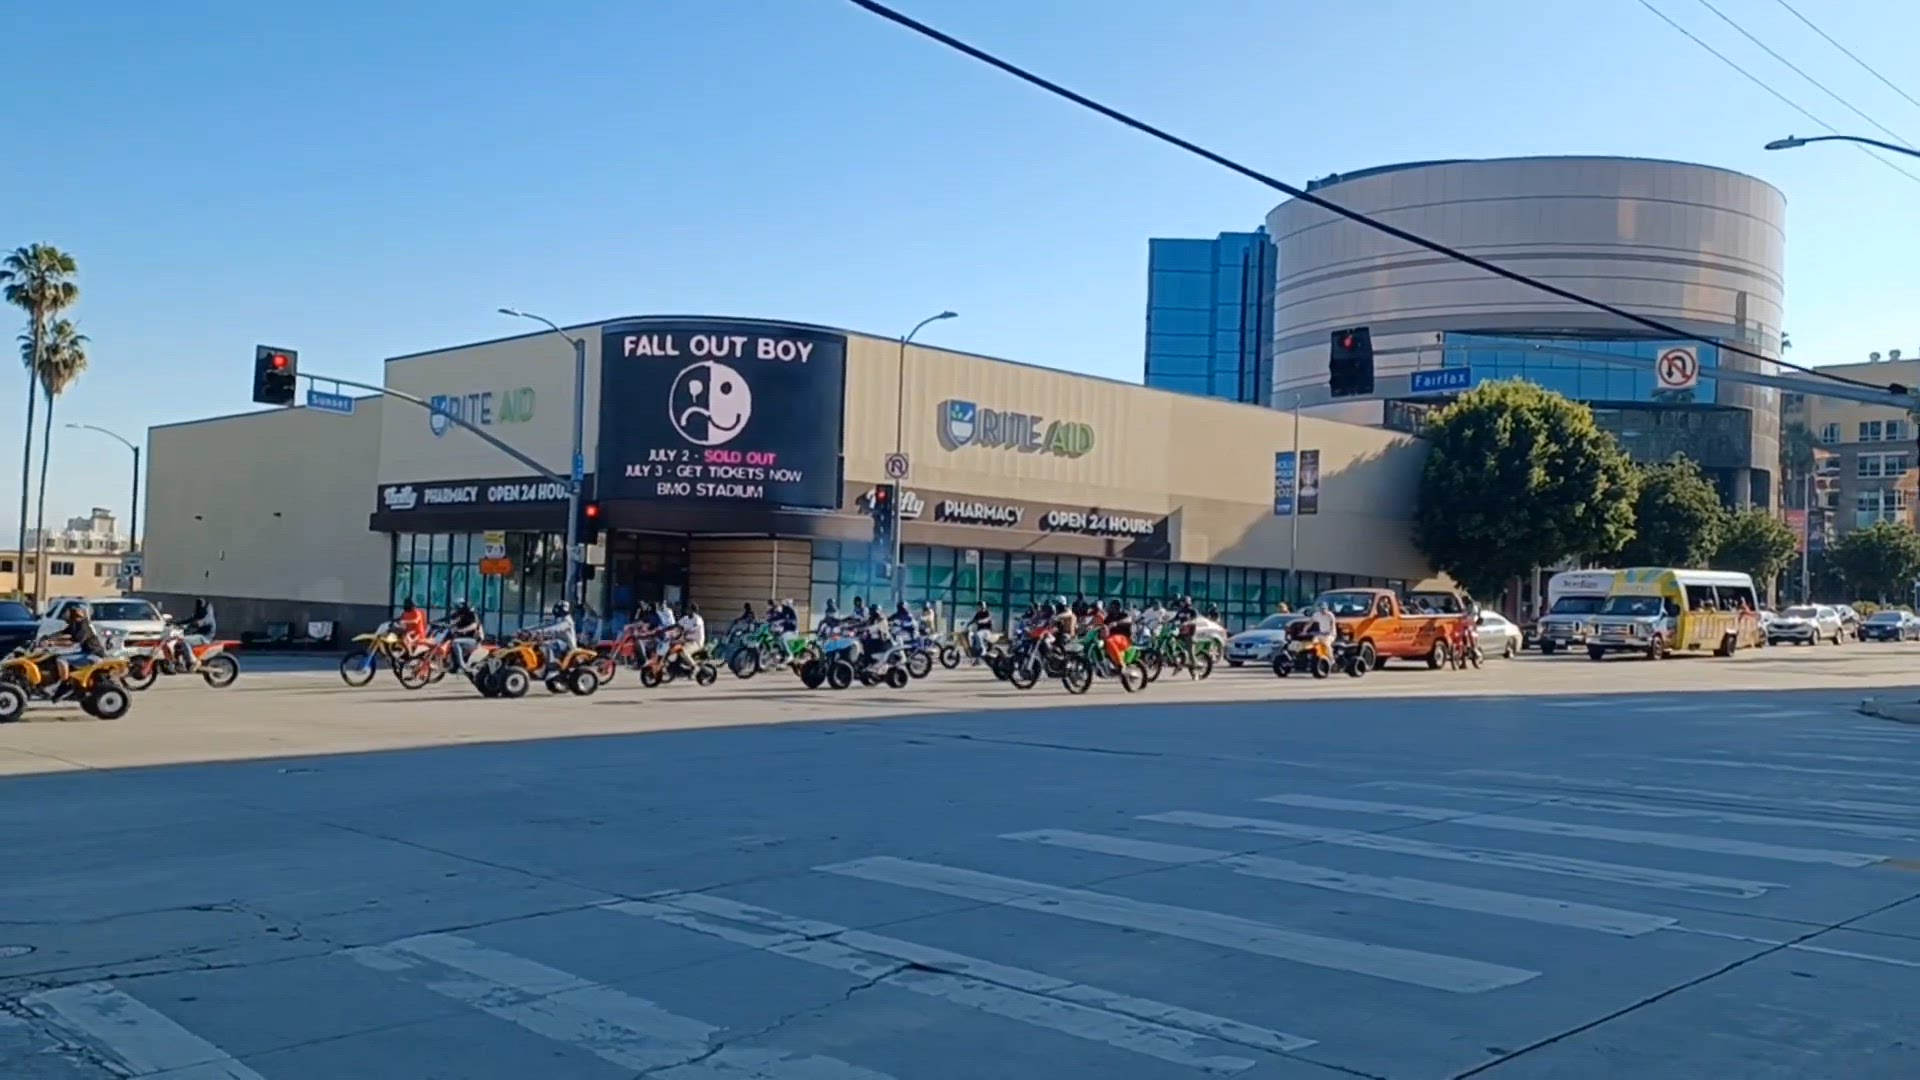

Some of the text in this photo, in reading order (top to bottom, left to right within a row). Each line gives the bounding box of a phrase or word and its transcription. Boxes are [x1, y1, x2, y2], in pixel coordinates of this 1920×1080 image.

[623, 335, 813, 363] FALL OUT BOY
[1415, 373, 1466, 387] Fairfax
[310, 394, 350, 410] Sunset
[449, 387, 536, 427] RITE AID
[977, 407, 1095, 455] RITE AID
[648, 449, 677, 462] JULY
[682, 450, 690, 462] 2
[704, 450, 741, 463] SOLD
[746, 452, 776, 465] OUT
[625, 464, 651, 477] JULY
[655, 466, 663, 477] 3
[676, 465, 703, 478] GET
[708, 467, 764, 481] TICKETS
[769, 470, 802, 482] NOW
[423, 486, 478, 504] PHARMACY
[487, 486, 519, 502] OPEN
[521, 484, 537, 500] 24
[538, 482, 571, 500] HOU
[657, 482, 763, 499] BMO STADIUM
[944, 500, 1024, 522] PHARMACY
[1048, 510, 1086, 528] OPEN
[1089, 514, 1106, 530] 24
[1109, 515, 1154, 534] HOURS
